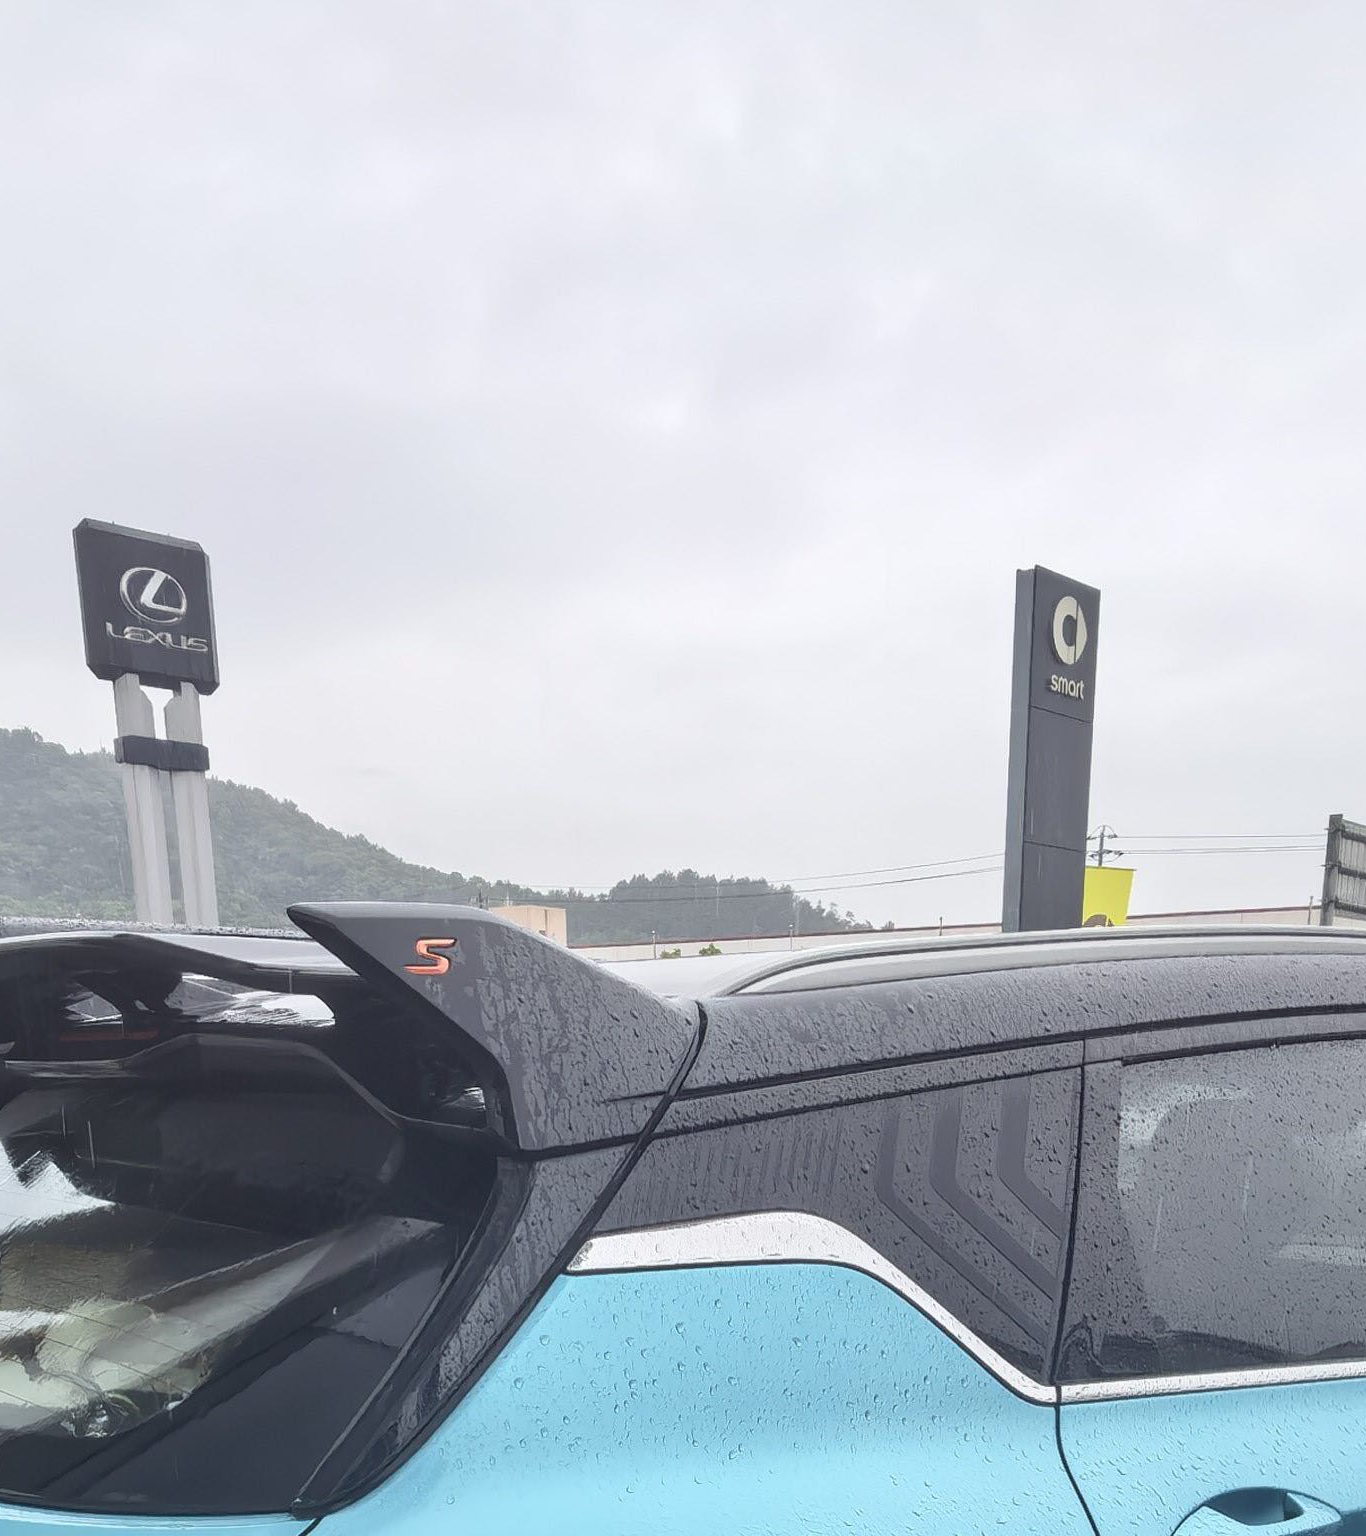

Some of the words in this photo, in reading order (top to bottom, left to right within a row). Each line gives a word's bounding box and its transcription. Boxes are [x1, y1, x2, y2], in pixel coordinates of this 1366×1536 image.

[105, 621, 209, 652] LEXUS
[1050, 673, 1085, 700] smart
[403, 938, 456, 976] S
